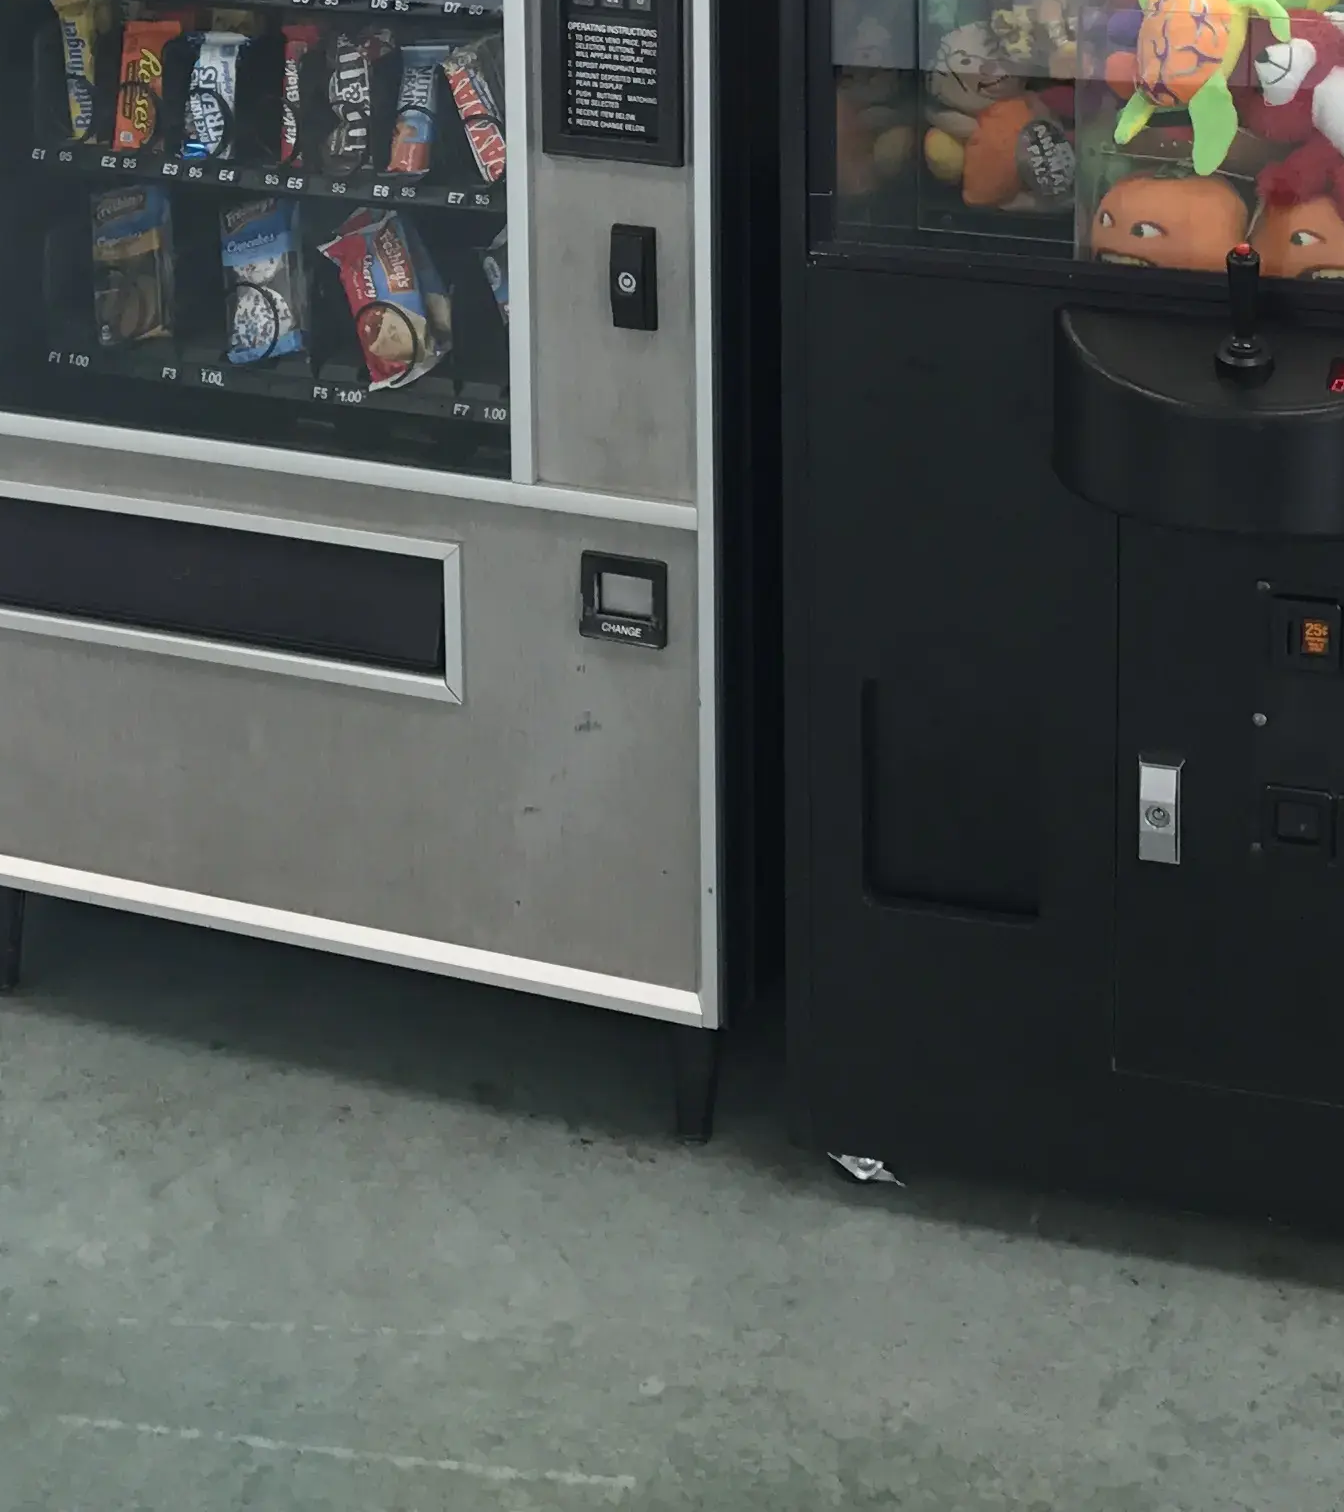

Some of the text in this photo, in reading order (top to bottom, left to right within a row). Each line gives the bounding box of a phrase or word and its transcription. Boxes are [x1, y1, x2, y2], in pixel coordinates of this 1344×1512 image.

[444, 2, 460, 14] D7
[32, 148, 46, 160] E1
[101, 156, 137, 169] E2 95
[162, 163, 203, 178] E3 95
[219, 170, 279, 185] E4 95
[287, 177, 346, 194] E5 95
[373, 185, 415, 197] E6 95
[448, 192, 489, 205] E7 95
[48, 352, 89, 367] F1 1.00
[162, 368, 177, 379] F3
[313, 387, 328, 399] F5
[453, 404, 506, 420] F7 1.00
[601, 621, 642, 638] CHANGE
[1305, 622, 1328, 637] 25¢
